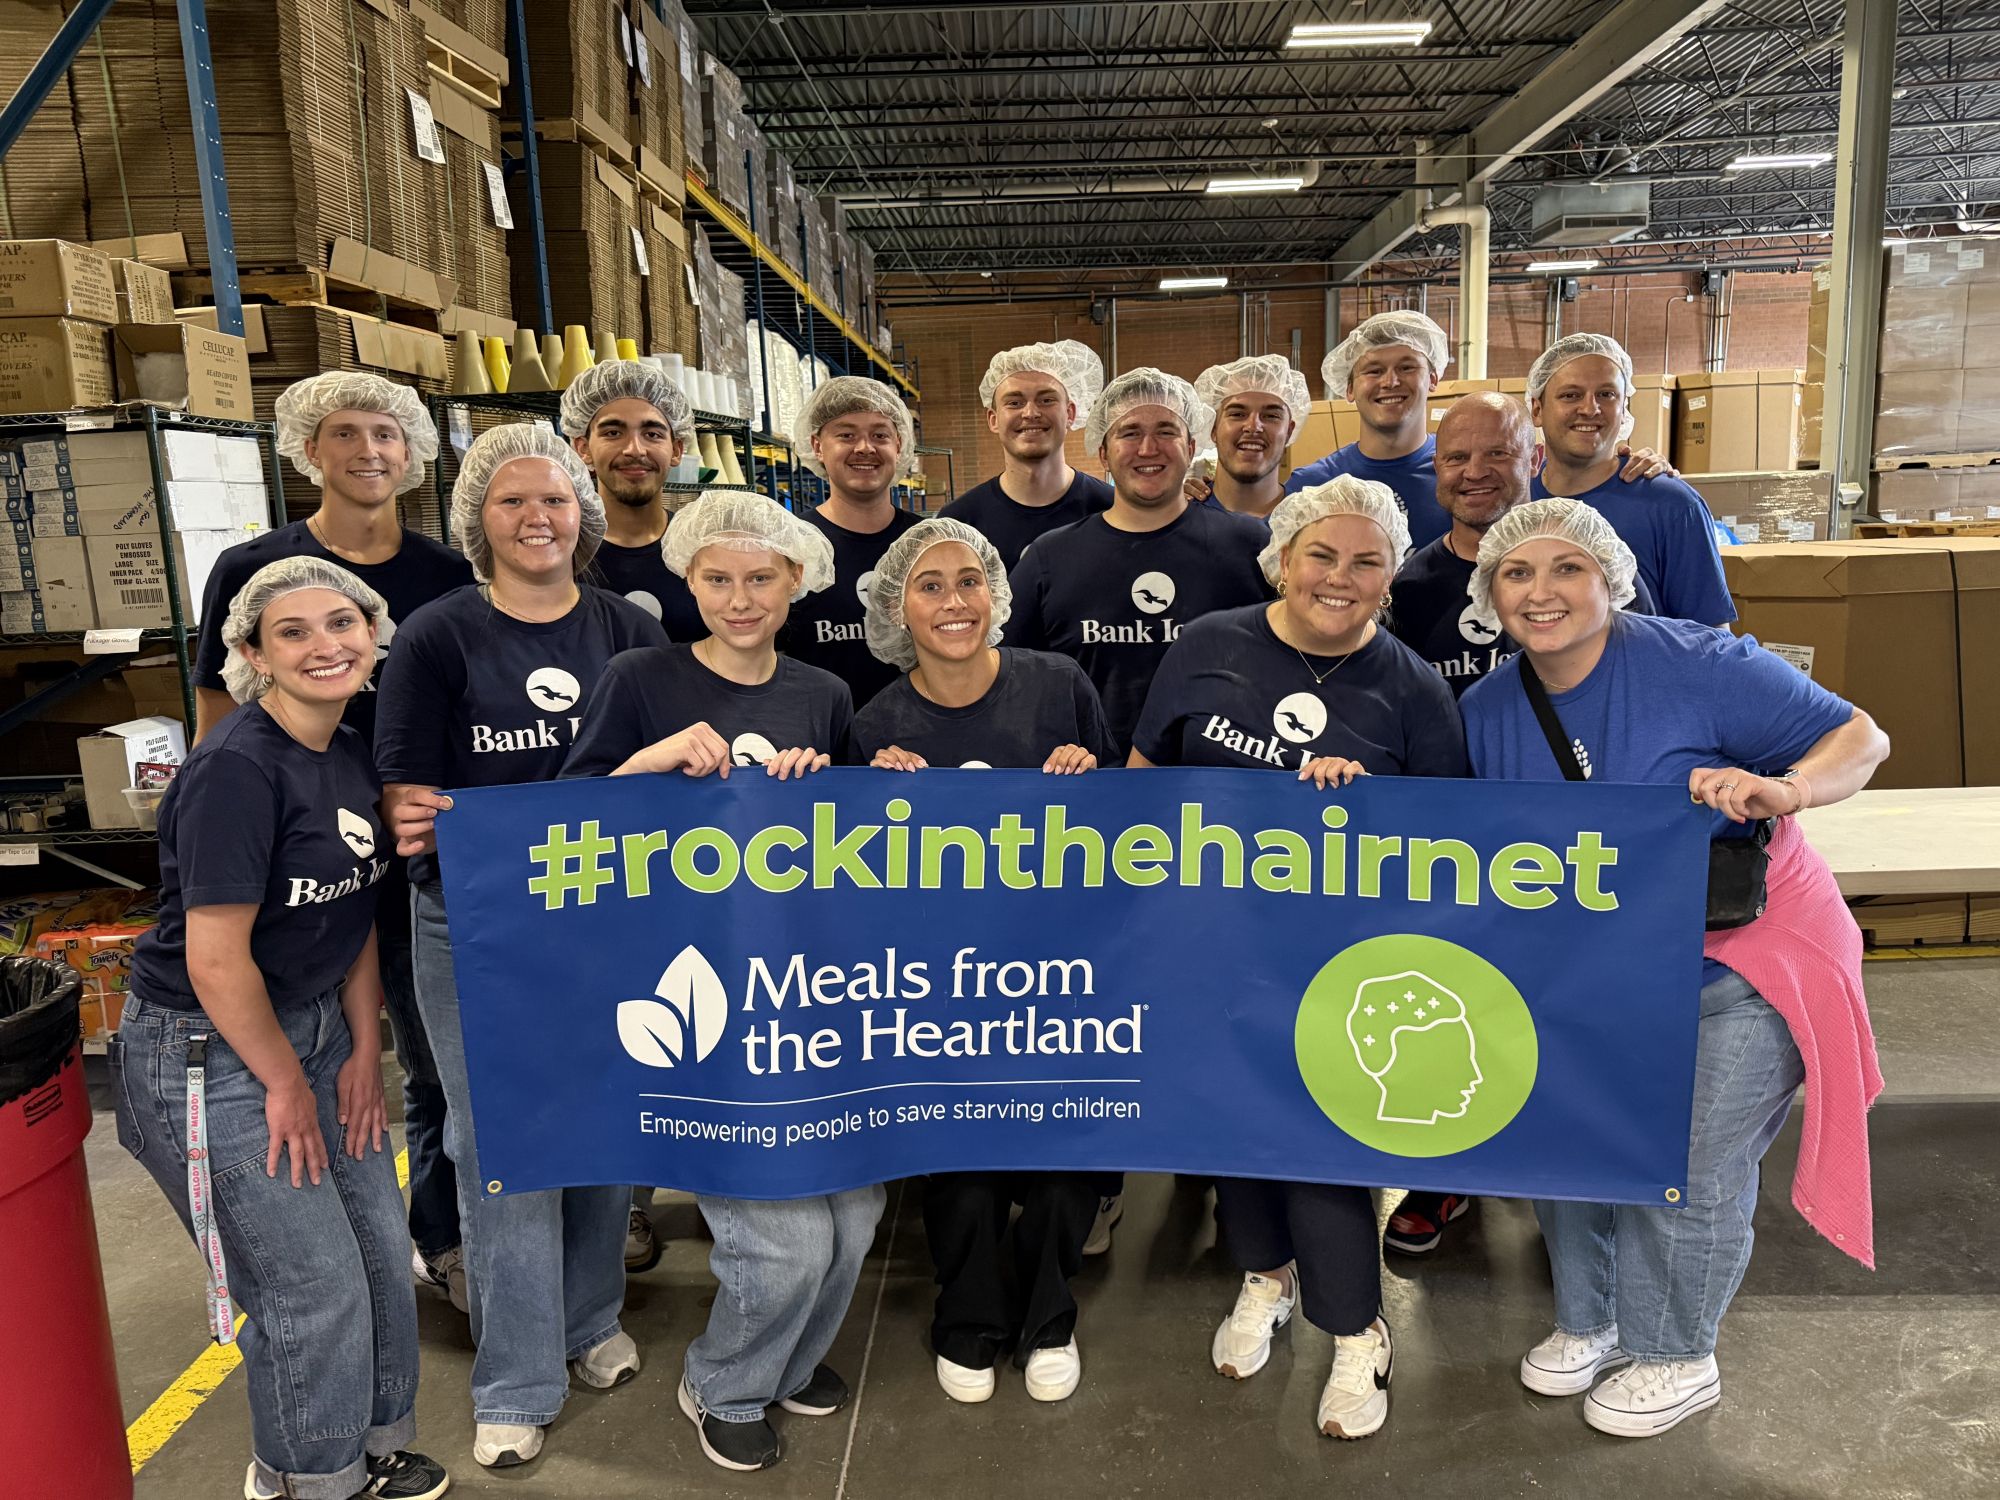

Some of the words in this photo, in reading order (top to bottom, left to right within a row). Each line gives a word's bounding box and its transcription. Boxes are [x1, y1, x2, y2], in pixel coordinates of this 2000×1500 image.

[202, 340, 235, 357] CELLUCAP
[120, 551, 151, 559] EMBOSSED
[131, 542, 153, 550] GLOVES
[115, 560, 134, 568] LARGE
[1080, 618, 1154, 643] Bank
[471, 719, 560, 753] Bank
[1201, 714, 1288, 768] Bank
[528, 798, 1619, 911] #rockinthehairnet
[284, 867, 366, 907] Bank
[89, 951, 119, 967] Towels
[742, 947, 931, 1012] Meals
[951, 947, 1096, 998] from
[741, 1019, 842, 1076] the
[191, 1092, 199, 1128] MELODY
[639, 1111, 777, 1148] Empowering
[786, 1110, 862, 1147] people
[868, 1107, 889, 1128] to
[896, 1102, 946, 1124] save
[952, 1099, 1045, 1122] starving
[1051, 1096, 1141, 1119] children
[191, 1129, 198, 1142] MY
[192, 1165, 201, 1198] MELODY
[194, 1199, 203, 1212] MY
[211, 1234, 221, 1266] MELODY
[216, 1268, 223, 1280] MY
[220, 1303, 231, 1336] MELODY
